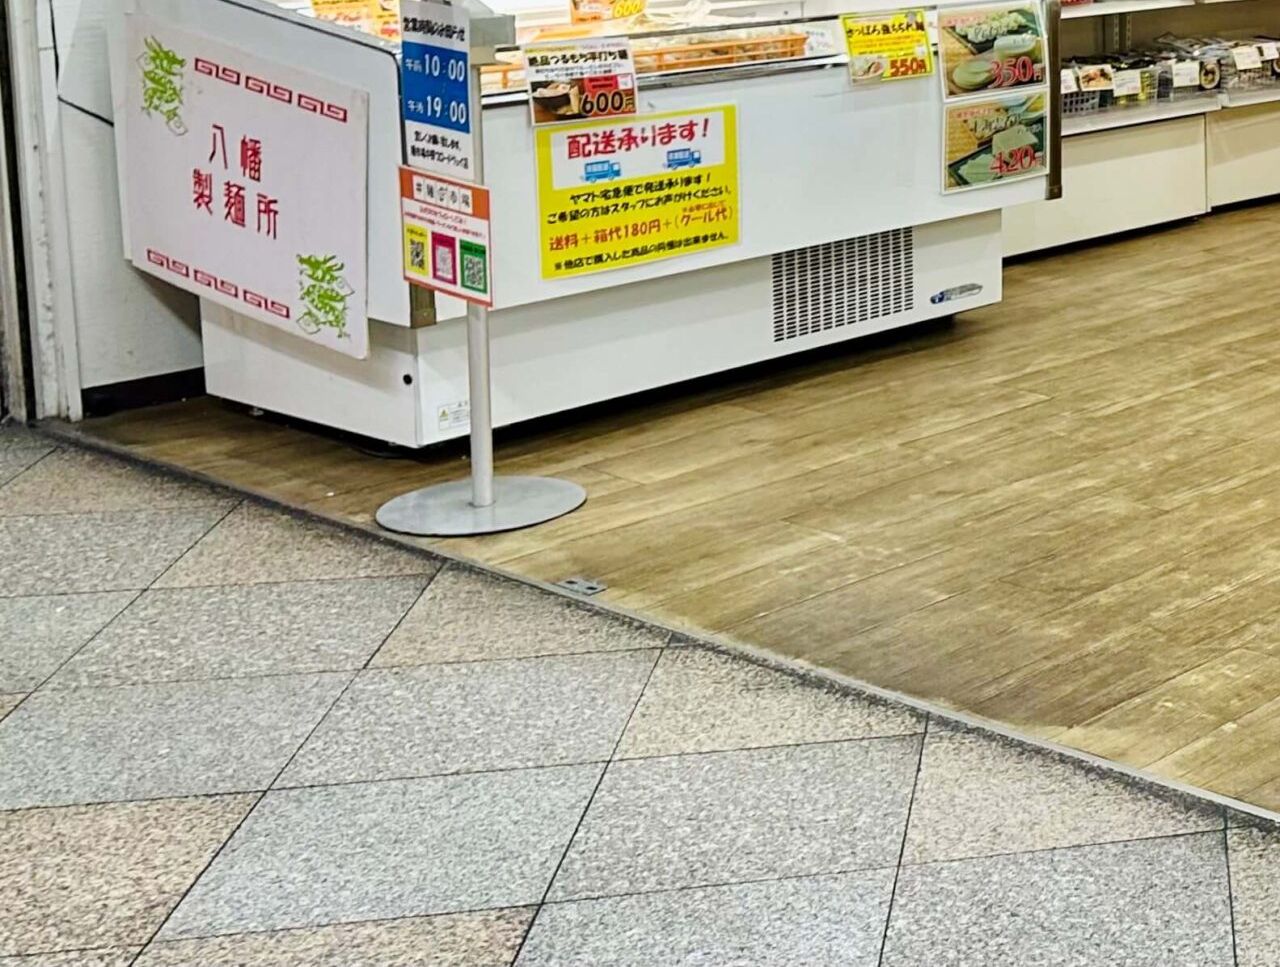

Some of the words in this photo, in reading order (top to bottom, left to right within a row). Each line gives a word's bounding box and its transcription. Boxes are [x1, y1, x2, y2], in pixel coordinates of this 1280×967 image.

[424, 53, 466, 82] 10:00
[426, 95, 467, 124] 19:00
[208, 123, 263, 183] 八幡
[567, 118, 710, 160] 配送承ります！
[192, 168, 280, 241] 製麺所
